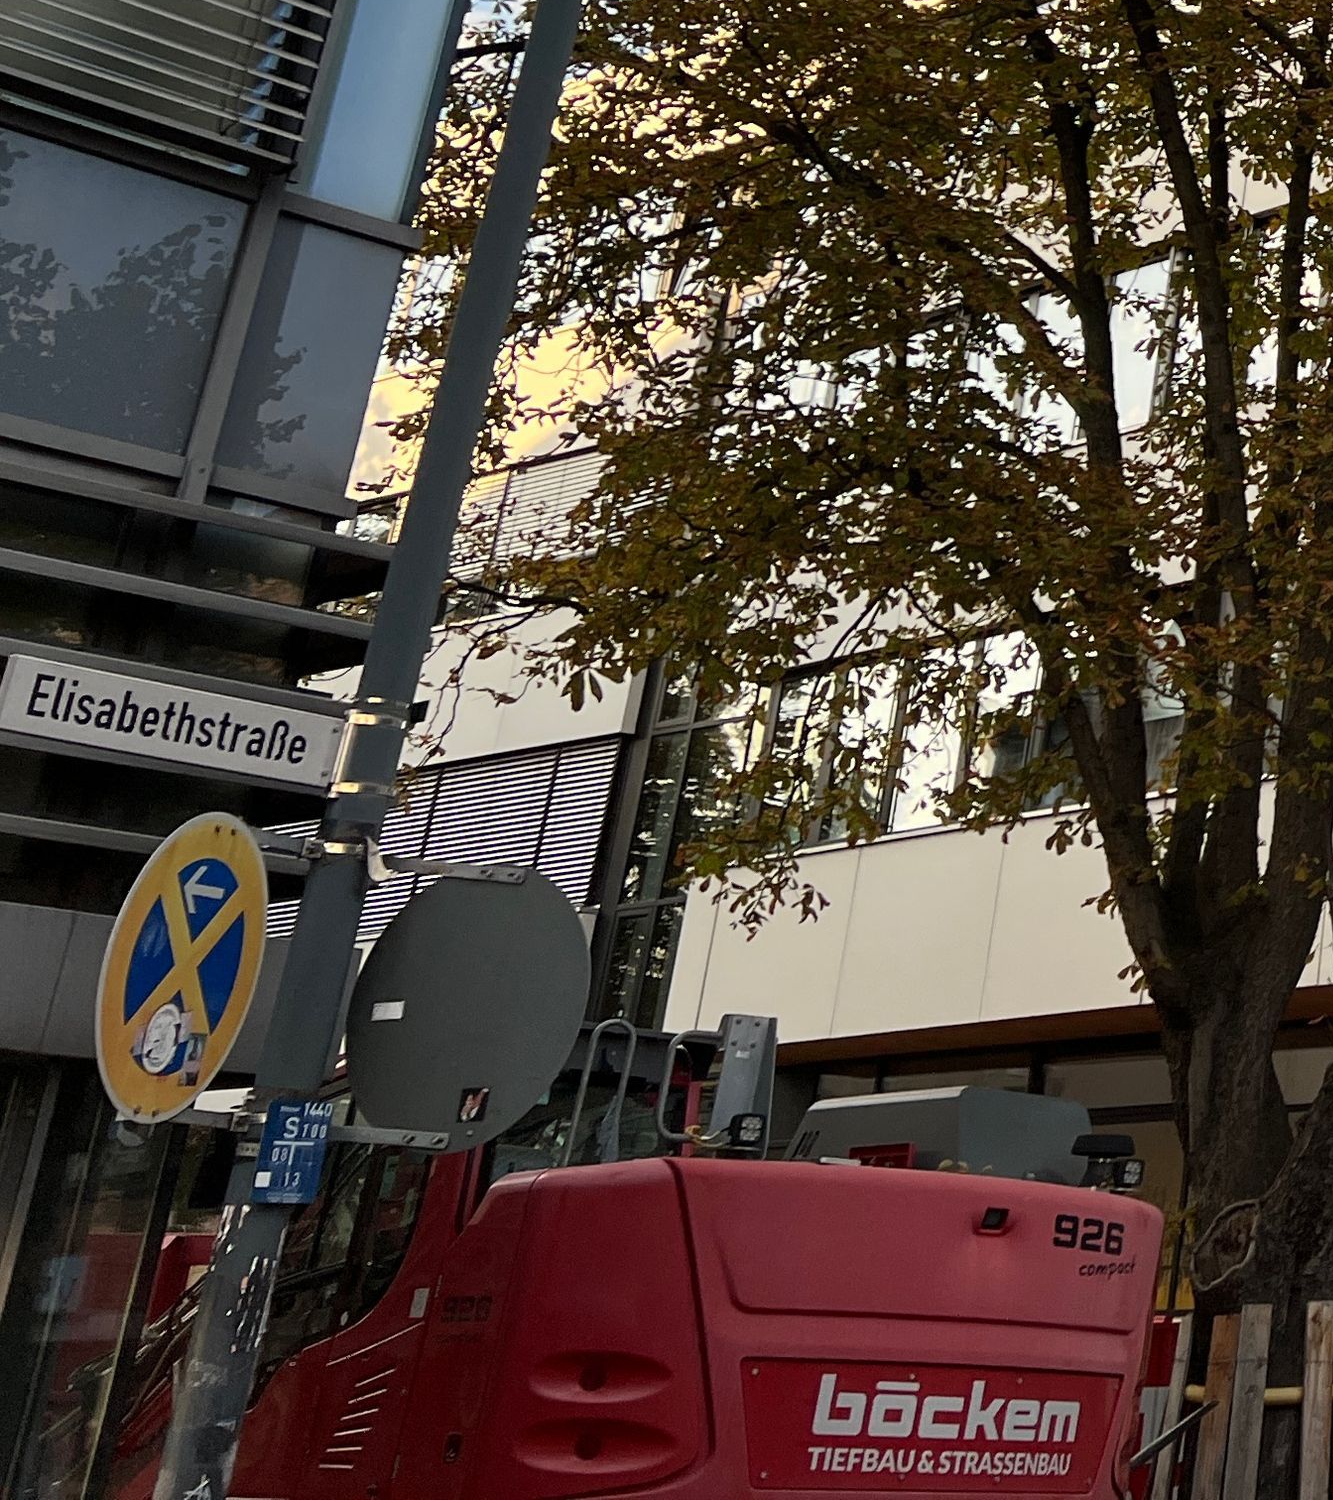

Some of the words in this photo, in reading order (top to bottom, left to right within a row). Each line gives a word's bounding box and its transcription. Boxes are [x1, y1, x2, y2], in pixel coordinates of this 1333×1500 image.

[26, 673, 307, 764] Elisabethstraße
[303, 1101, 333, 1117] 1440
[283, 1116, 300, 1139] S
[302, 1123, 327, 1139] 100
[1053, 1214, 1125, 1256] 926
[812, 1373, 1081, 1442] böckem
[808, 1447, 917, 1473] TIEFBAU
[917, 1450, 935, 1473] &
[938, 1451, 1072, 1476] STRASSENBAU
